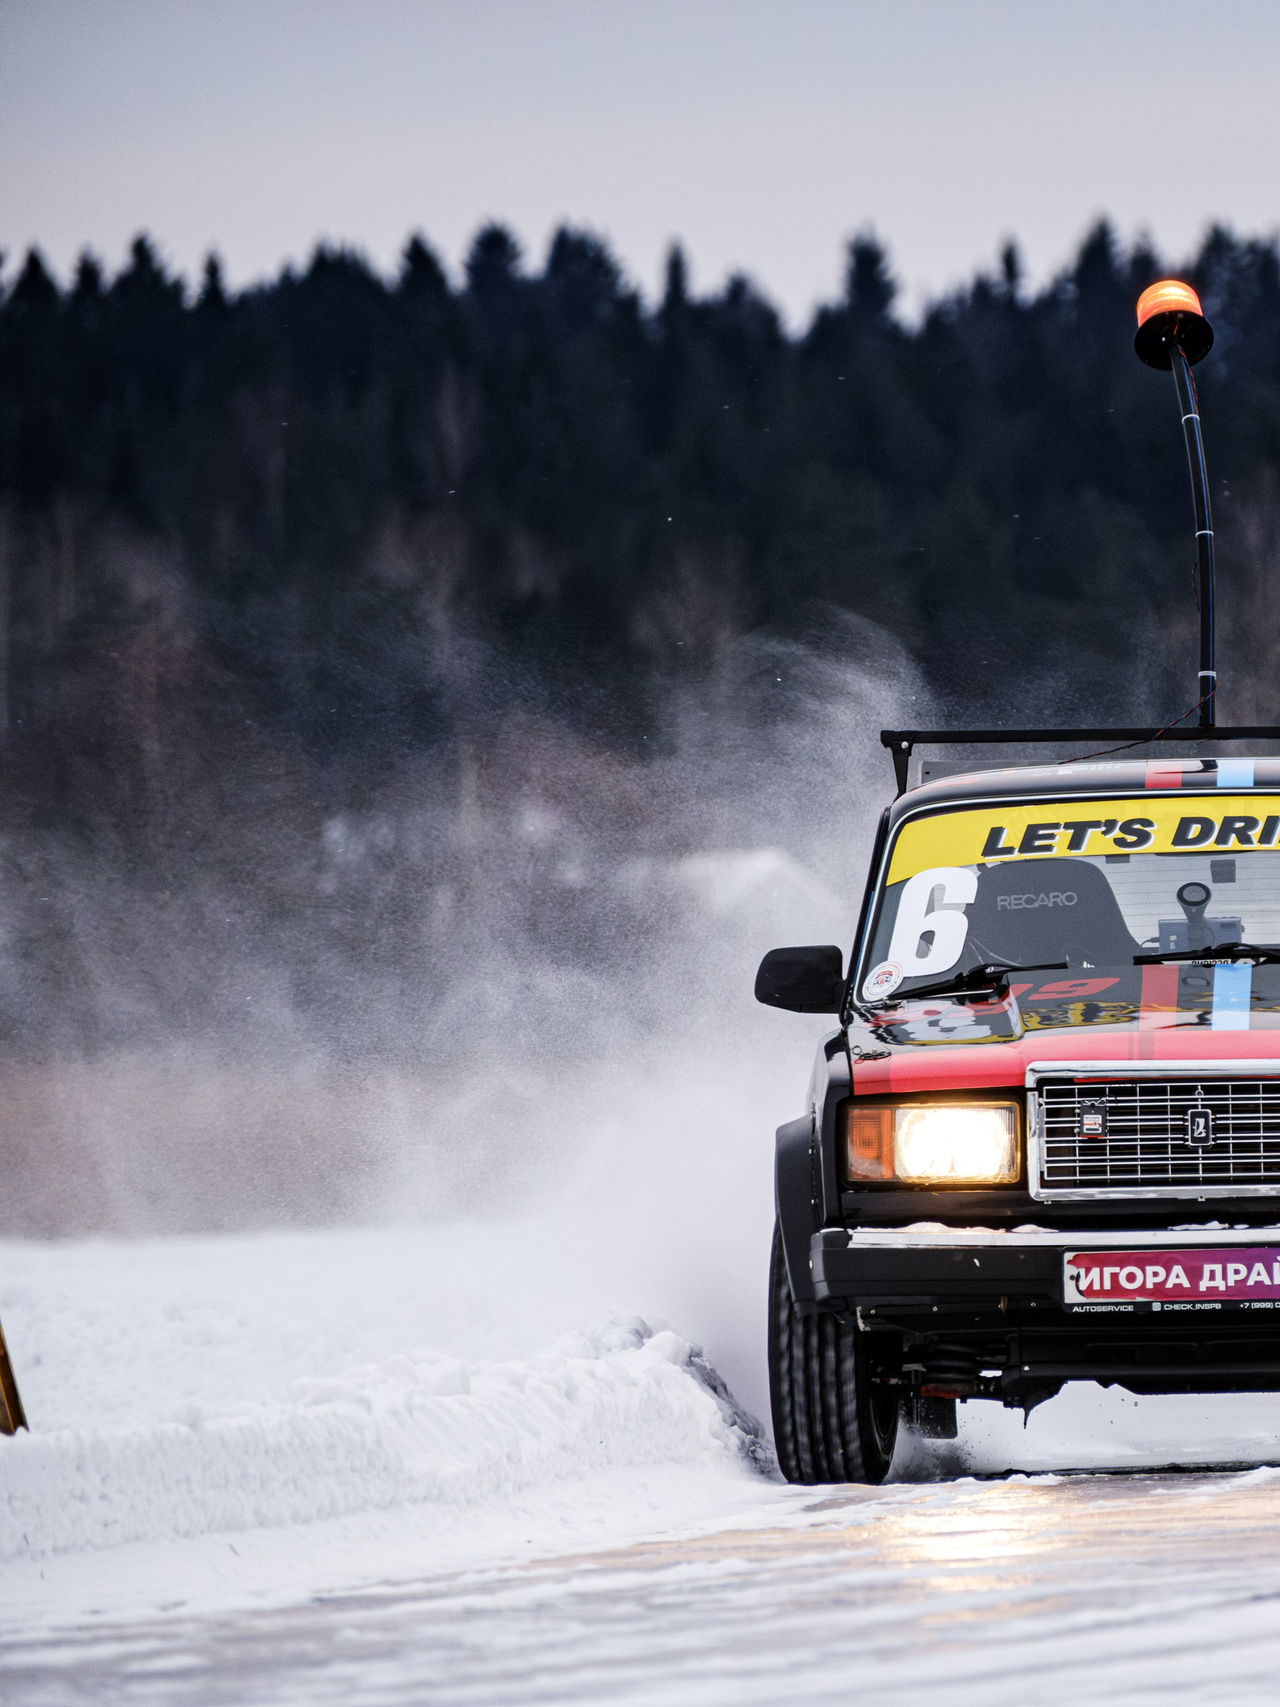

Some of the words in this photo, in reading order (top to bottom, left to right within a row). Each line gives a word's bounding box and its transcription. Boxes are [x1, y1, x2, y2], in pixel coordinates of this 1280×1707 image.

[980, 816, 1156, 859] LET'S
[997, 891, 1078, 911] RECARO
[889, 866, 979, 978] 6
[1078, 1264, 1191, 1291] ИГОРА
[1072, 1305, 1134, 1313] AUTOSERVICE
